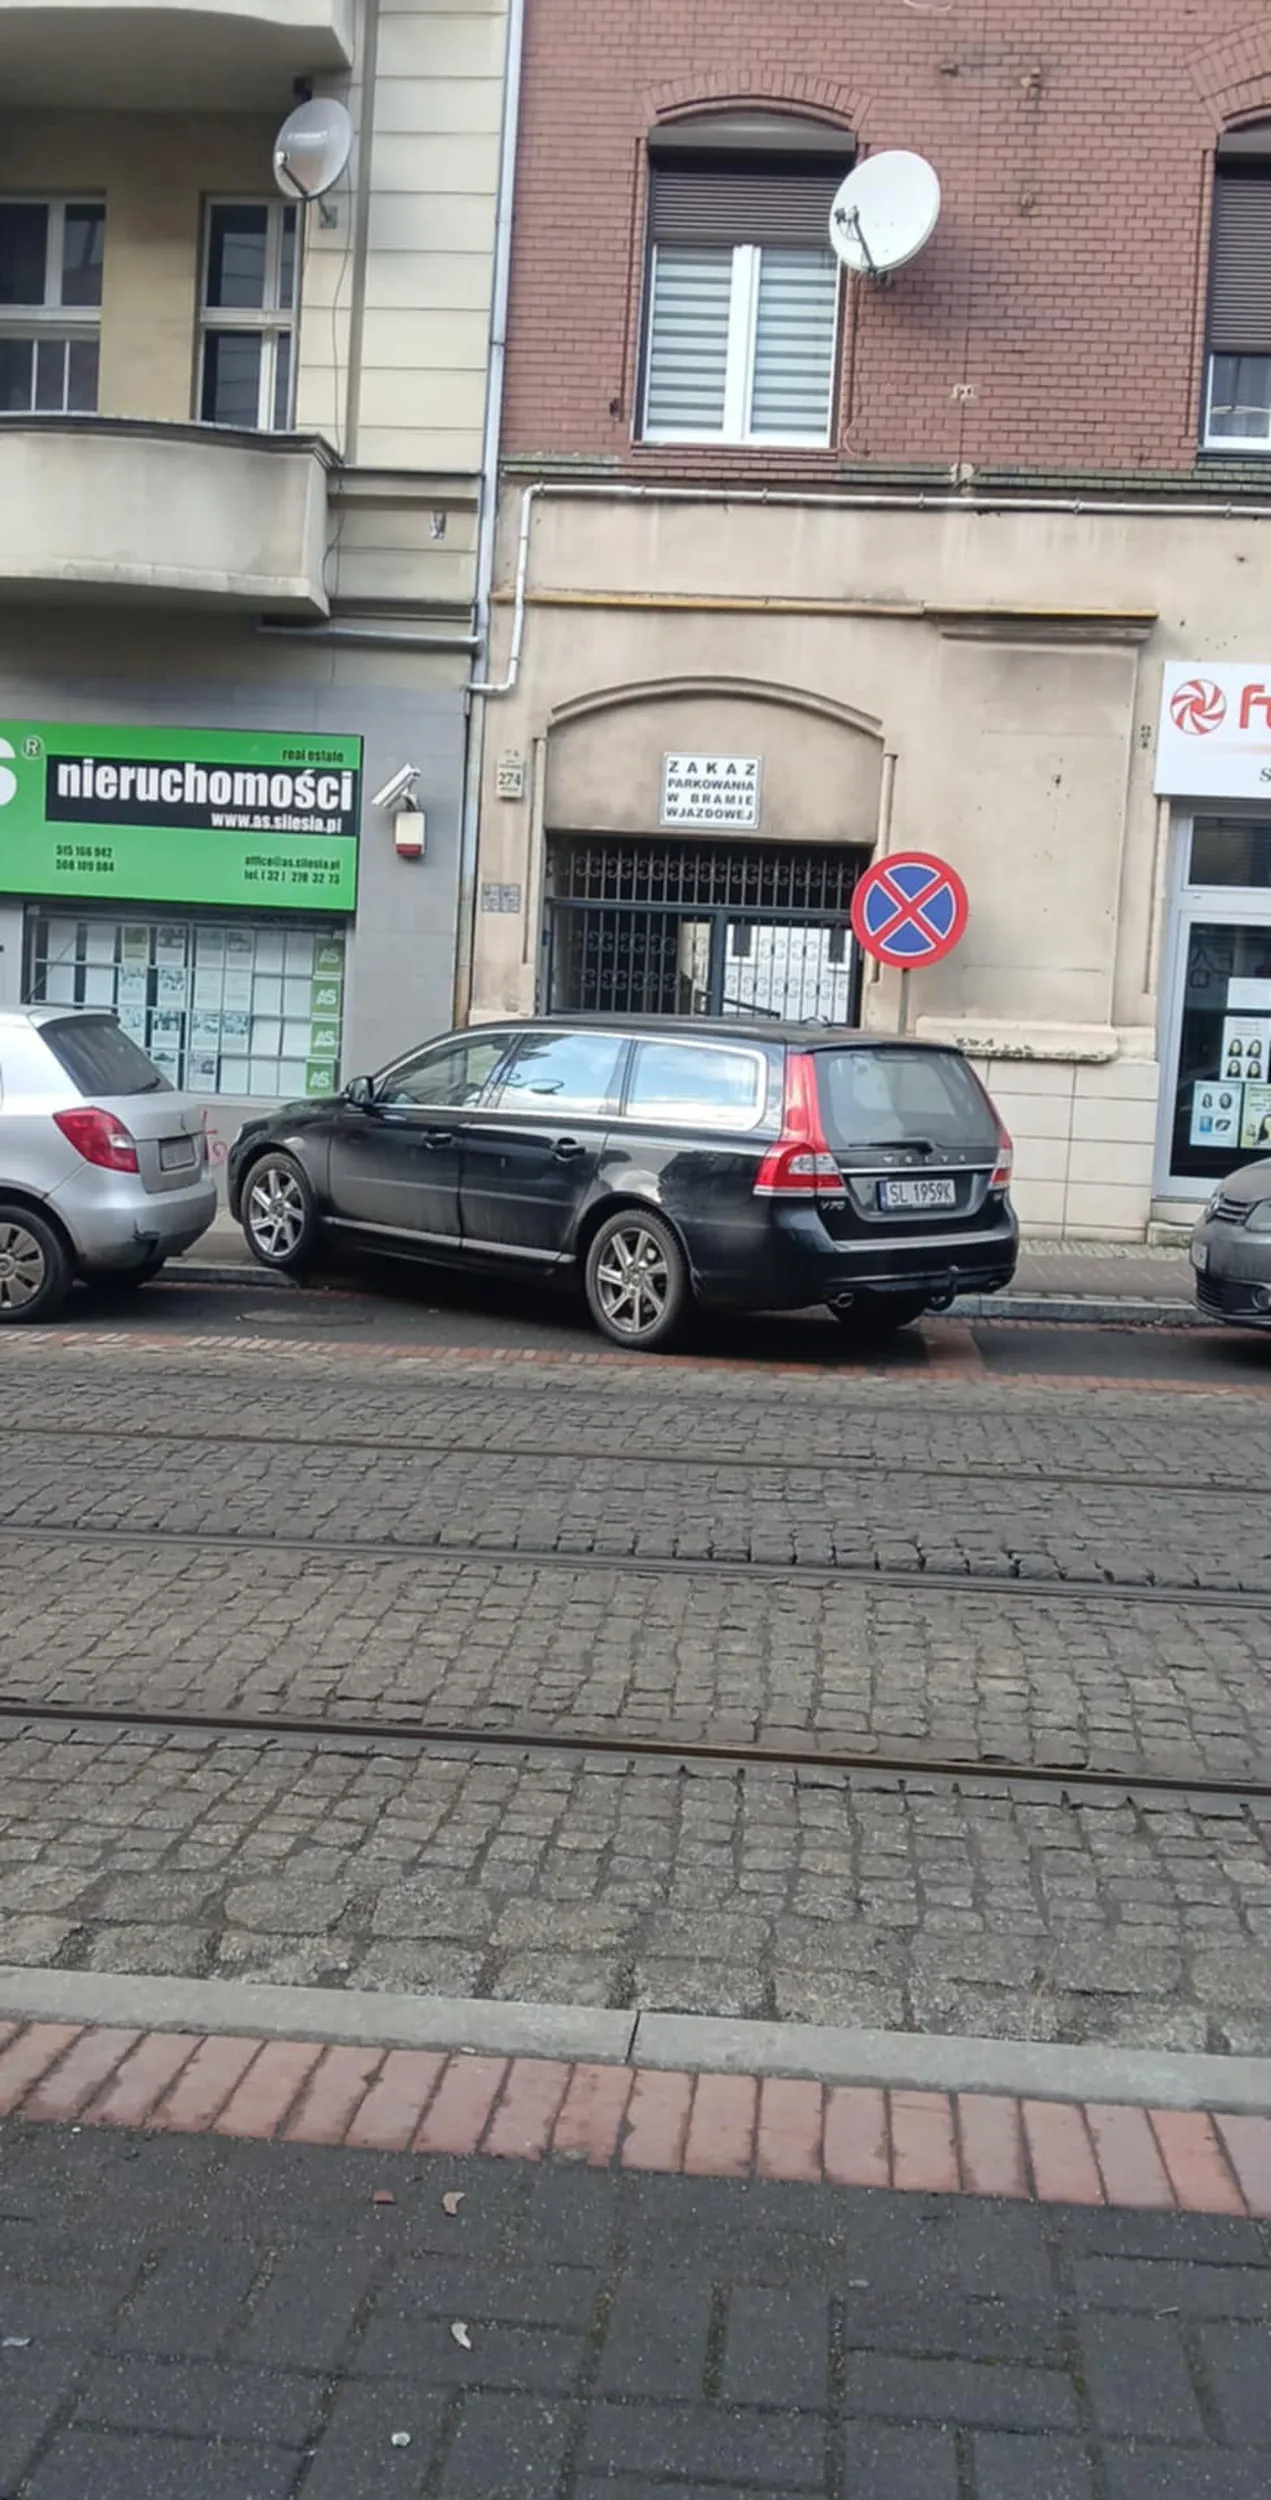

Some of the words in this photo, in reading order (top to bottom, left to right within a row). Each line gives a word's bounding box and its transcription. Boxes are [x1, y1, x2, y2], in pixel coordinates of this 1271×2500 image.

[282, 749, 305, 761] real
[308, 750, 344, 763] estate
[668, 760, 755, 776] ZAKAZ
[57, 758, 353, 811] nieruchomości
[499, 772, 521, 786] 274
[667, 778, 755, 791] PARKOWANIA
[667, 793, 679, 803] W
[690, 793, 753, 806] BRAMIE
[666, 806, 753, 820] WJAZDOWEJ
[211, 812, 342, 834] www.as.silesia.pl
[316, 989, 336, 1005] AS
[314, 1030, 335, 1046] AS
[310, 1071, 329, 1088] AS
[889, 1184, 909, 1204] SL
[913, 1181, 952, 1202] 1959K
